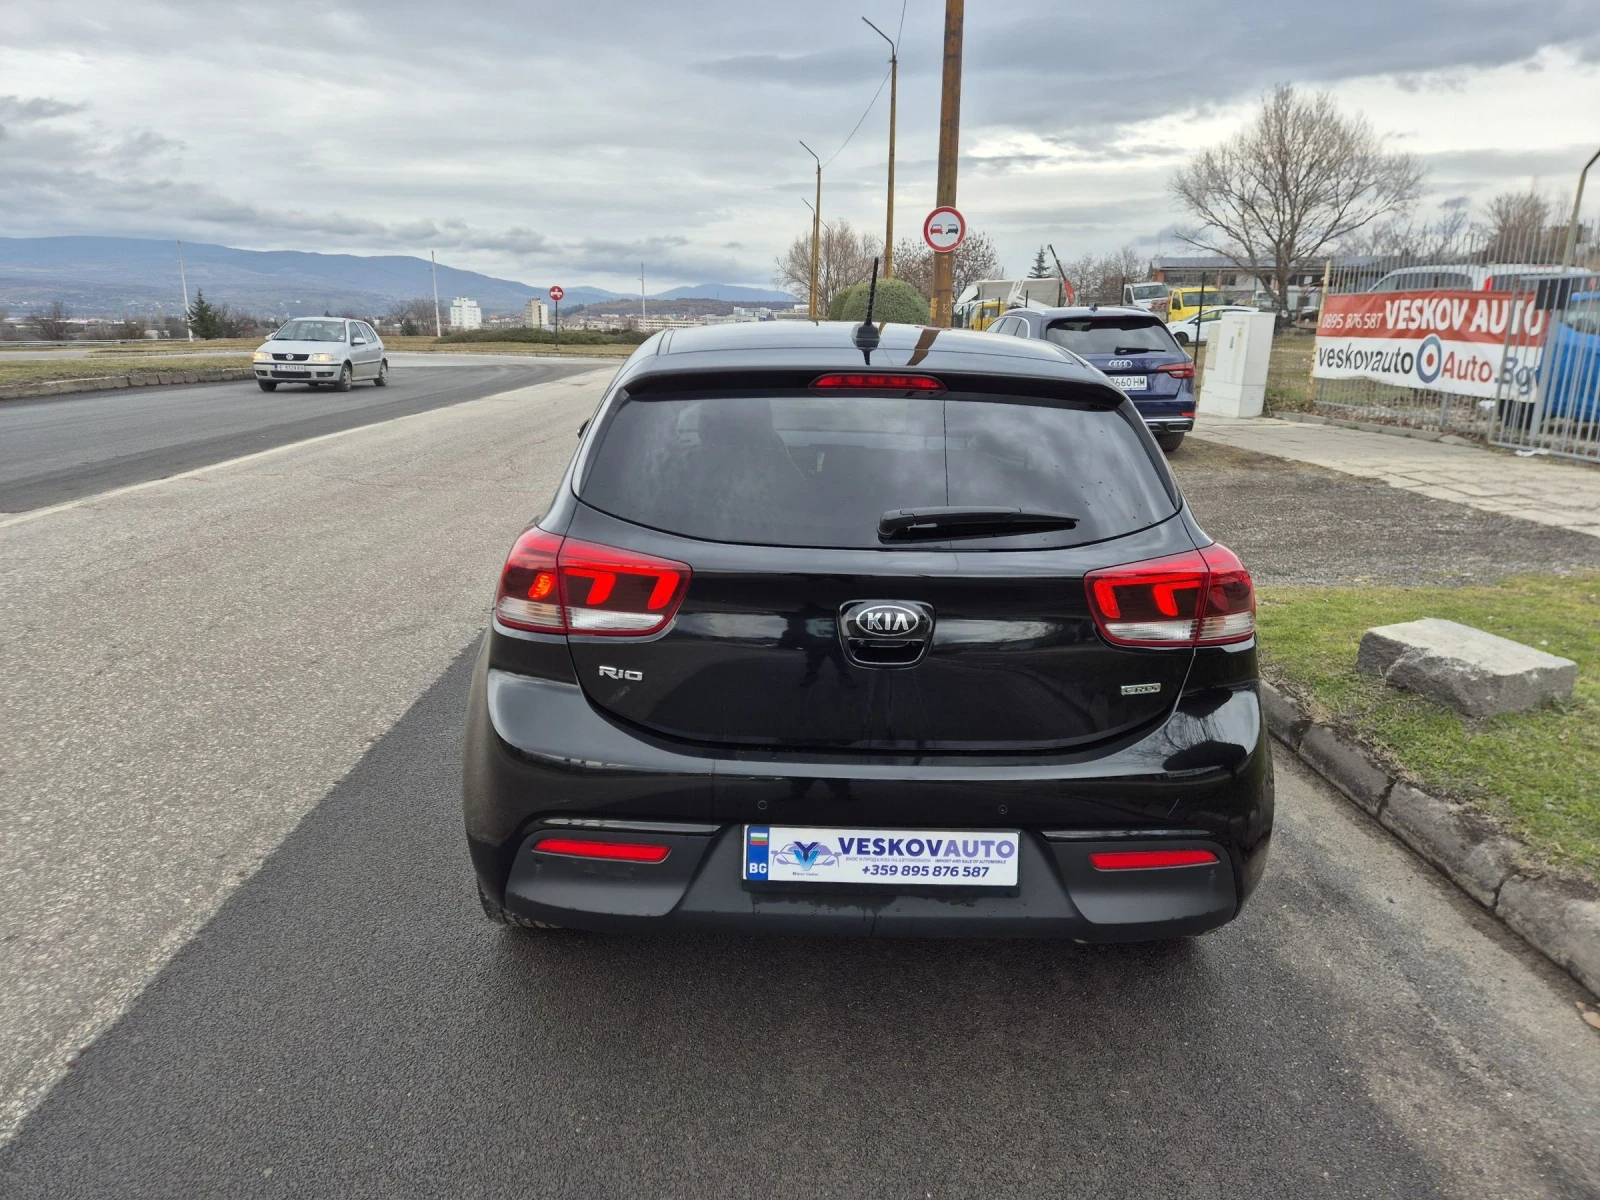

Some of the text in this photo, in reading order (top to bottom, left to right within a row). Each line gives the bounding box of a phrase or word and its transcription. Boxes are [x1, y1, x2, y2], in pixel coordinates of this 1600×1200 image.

[1321, 298, 1544, 337] 0895 876 587 VESKOV AUTO
[1319, 343, 1414, 375] veskovauto
[867, 612, 909, 631] KIA
[598, 665, 643, 681] RIO
[838, 837, 1015, 859] VESKOVAUTO
[749, 862, 768, 874] BG
[862, 864, 990, 878] +359 895 876 587
